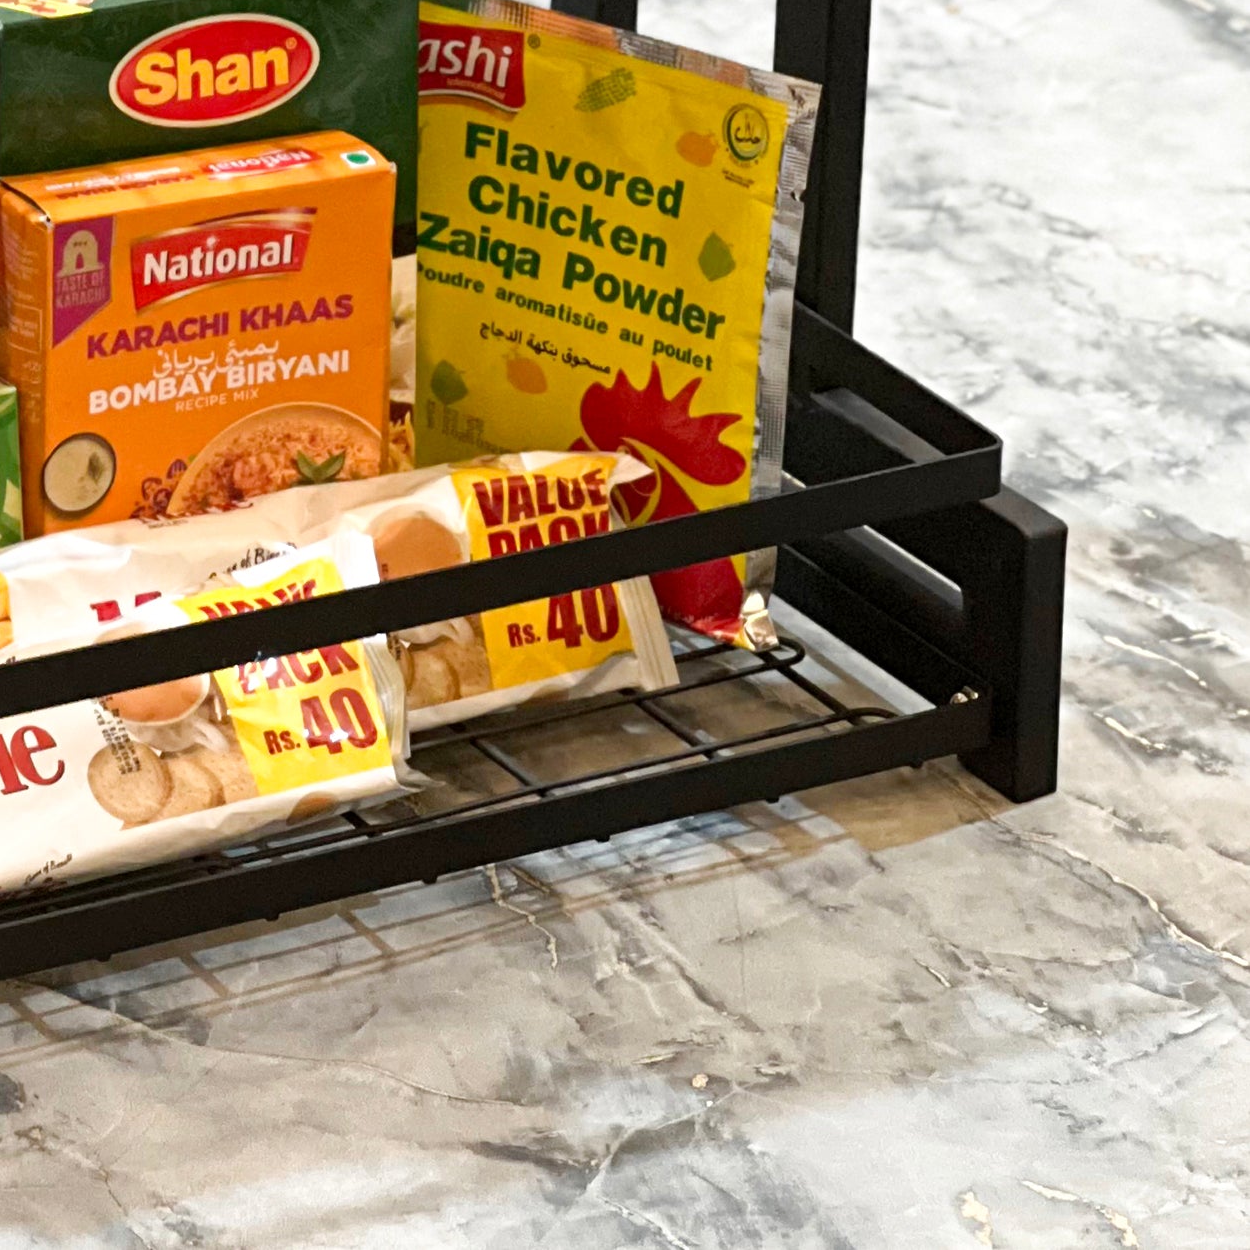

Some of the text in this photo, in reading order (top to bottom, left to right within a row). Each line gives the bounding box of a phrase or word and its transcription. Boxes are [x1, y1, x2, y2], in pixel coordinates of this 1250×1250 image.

[134, 45, 290, 107] Shan
[418, 35, 513, 88] ashi
[464, 121, 685, 219] Flavored
[467, 174, 668, 268] Chicken
[143, 232, 294, 287] National
[417, 211, 726, 341] Zaiqa Powder
[86, 313, 230, 360] KARACHI
[239, 294, 354, 334] KHAAS
[619, 328, 644, 346] au
[652, 339, 713, 372] poulet
[88, 348, 350, 415] BOMBAY BIRYANI
[175, 387, 260, 413] RECIPE MIX
[472, 467, 608, 529] VALUE
[507, 583, 620, 649] Rs. 40
[263, 687, 378, 755] Rs. 40
